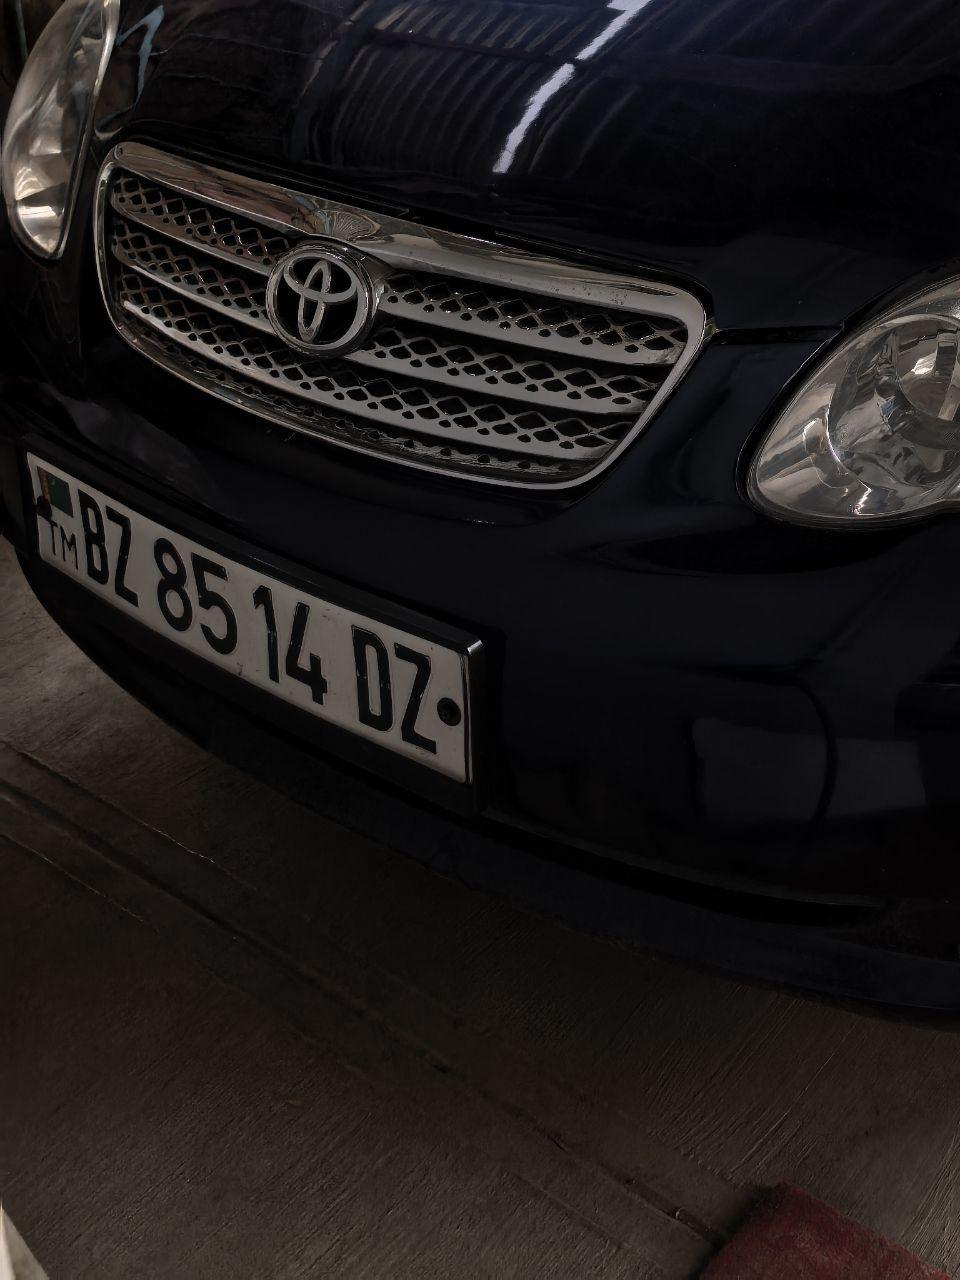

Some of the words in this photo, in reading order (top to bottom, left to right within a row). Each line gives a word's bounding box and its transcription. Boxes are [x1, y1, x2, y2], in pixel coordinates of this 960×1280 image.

[45, 521, 78, 570] TM
[78, 488, 139, 607] BZ
[351, 625, 437, 754] DZ
